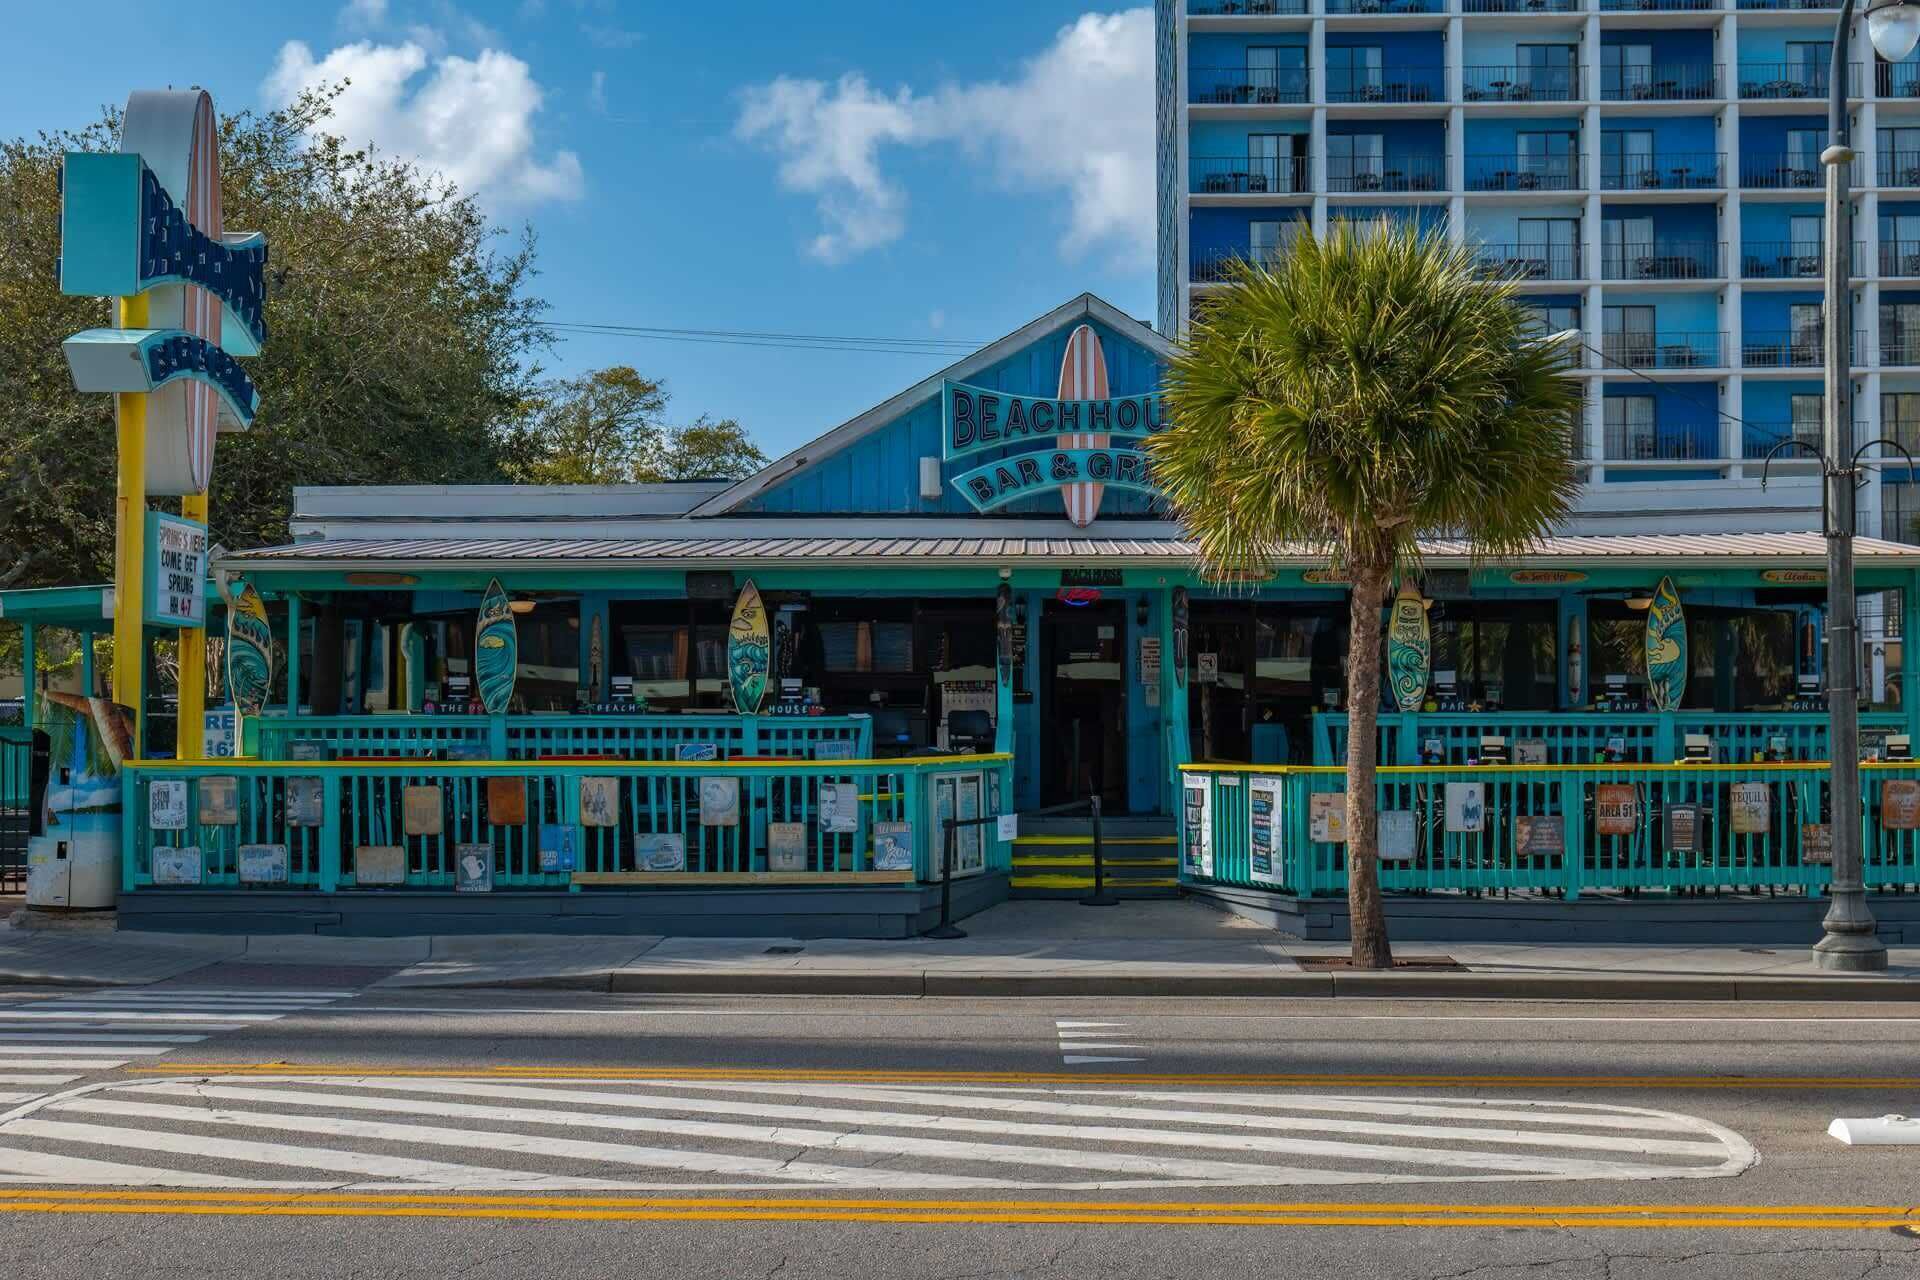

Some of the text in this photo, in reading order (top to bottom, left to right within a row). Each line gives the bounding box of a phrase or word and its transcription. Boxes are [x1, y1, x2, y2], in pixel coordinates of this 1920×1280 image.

[953, 389, 1166, 448] BEACH HOU
[967, 453, 1151, 504] BAR & GRI
[160, 526, 205, 553] SPRING'S HERE
[161, 550, 197, 576] COME GET
[168, 573, 194, 595] SPRUNG
[180, 599, 192, 616] 4-7
[439, 704, 464, 713] THE
[596, 704, 635, 713] BEACH
[768, 704, 808, 714] HOUSE
[1615, 702, 1638, 711] AND
[1732, 791, 1768, 804] TEQUILA
[1600, 803, 1632, 817] AREA 51
